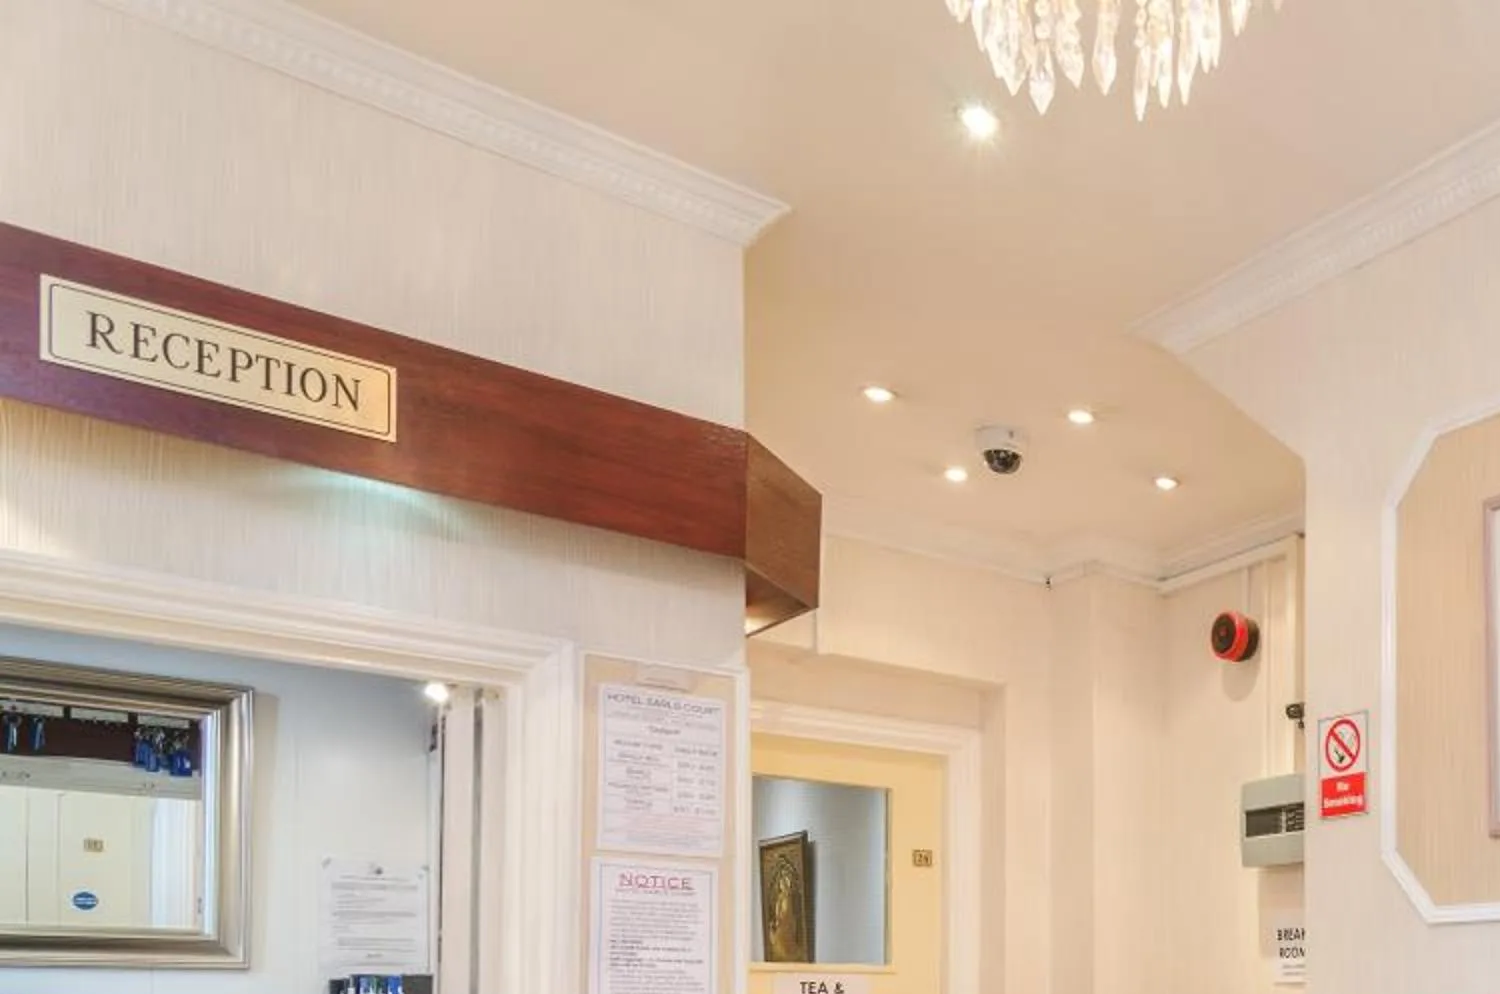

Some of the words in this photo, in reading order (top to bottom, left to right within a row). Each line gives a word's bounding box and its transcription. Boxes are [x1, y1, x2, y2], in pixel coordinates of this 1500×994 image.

[85, 310, 361, 411] RECEPTION
[607, 693, 643, 705] HOTEL
[684, 702, 721, 715] COURT
[619, 872, 696, 891] NOTICE
[799, 981, 829, 994] TEA
[833, 982, 845, 994] &
